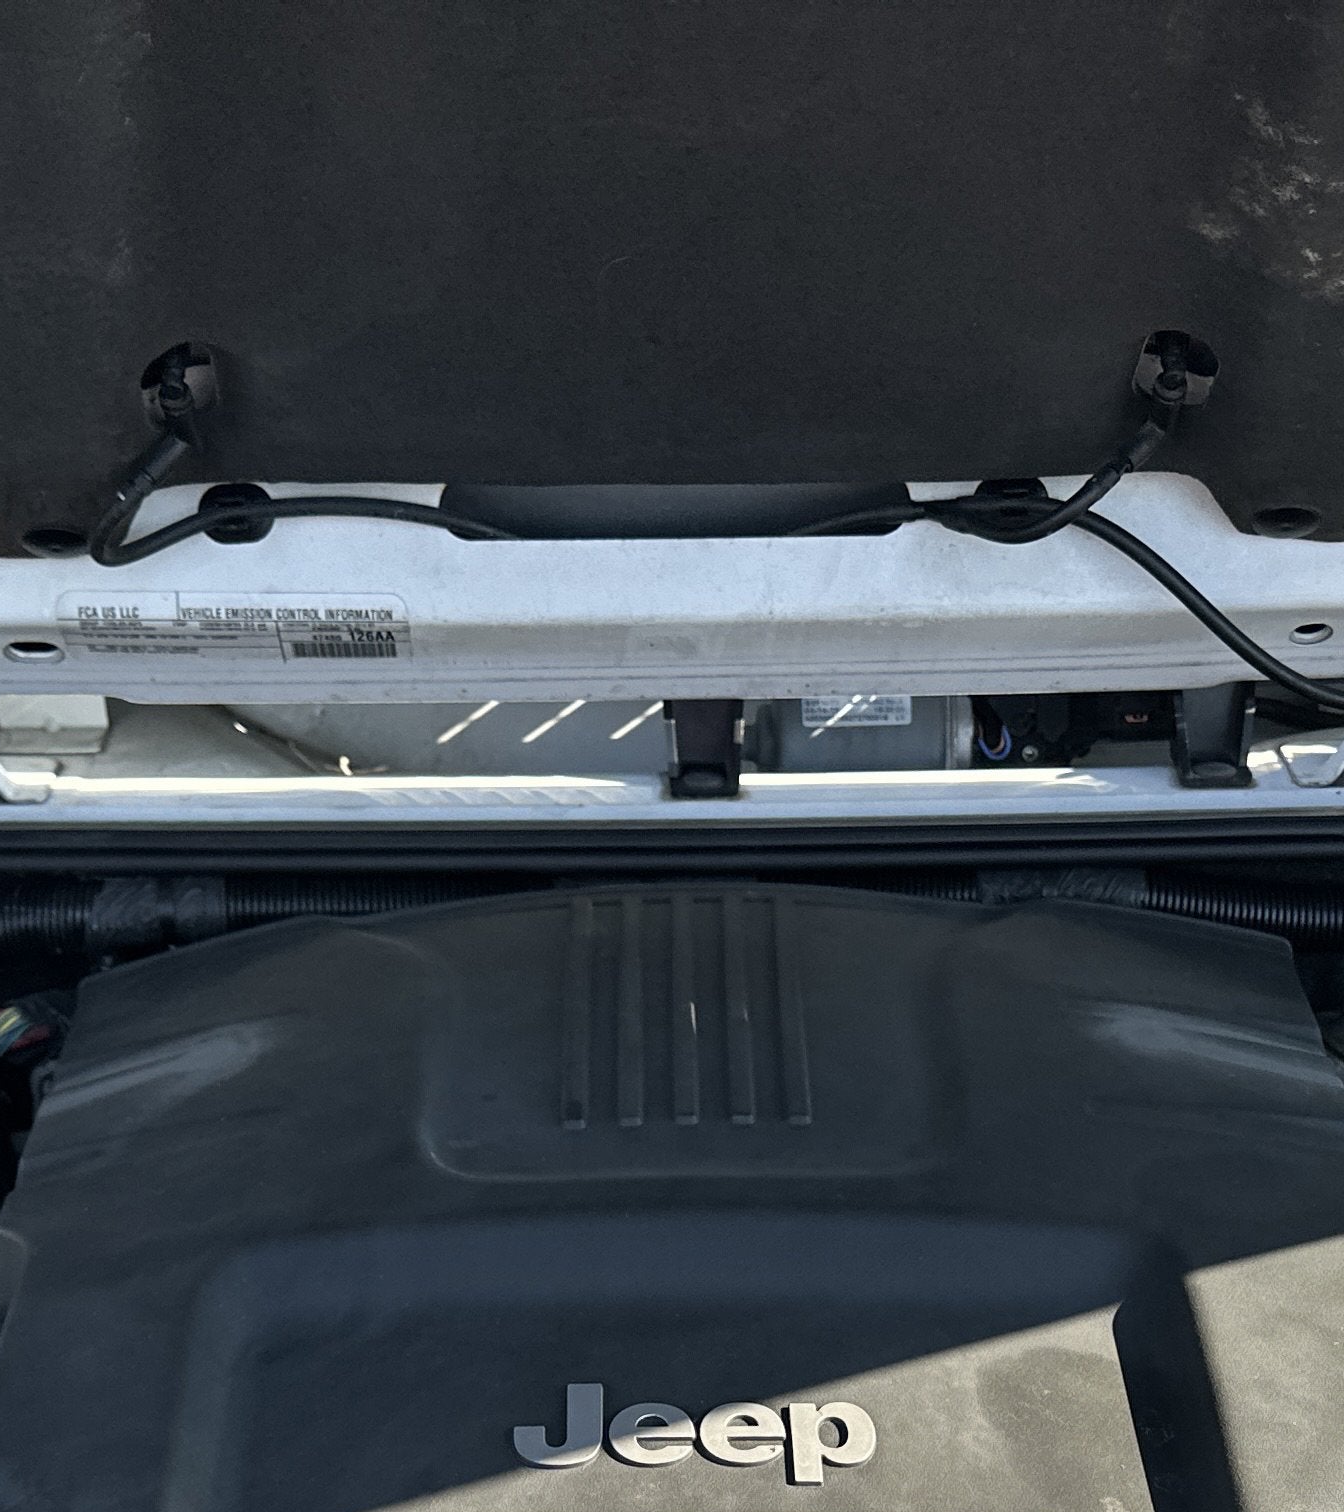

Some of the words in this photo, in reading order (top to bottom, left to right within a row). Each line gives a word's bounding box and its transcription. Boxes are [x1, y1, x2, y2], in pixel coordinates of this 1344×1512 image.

[77, 606, 99, 619] FCA
[101, 606, 117, 619] US
[119, 606, 141, 619] LLC
[180, 607, 223, 620] VEHICLE
[225, 608, 273, 620] EMISSION
[276, 608, 322, 621] CONTROL
[324, 609, 394, 621] INFORMATION
[514, 1382, 878, 1487] Jeep
